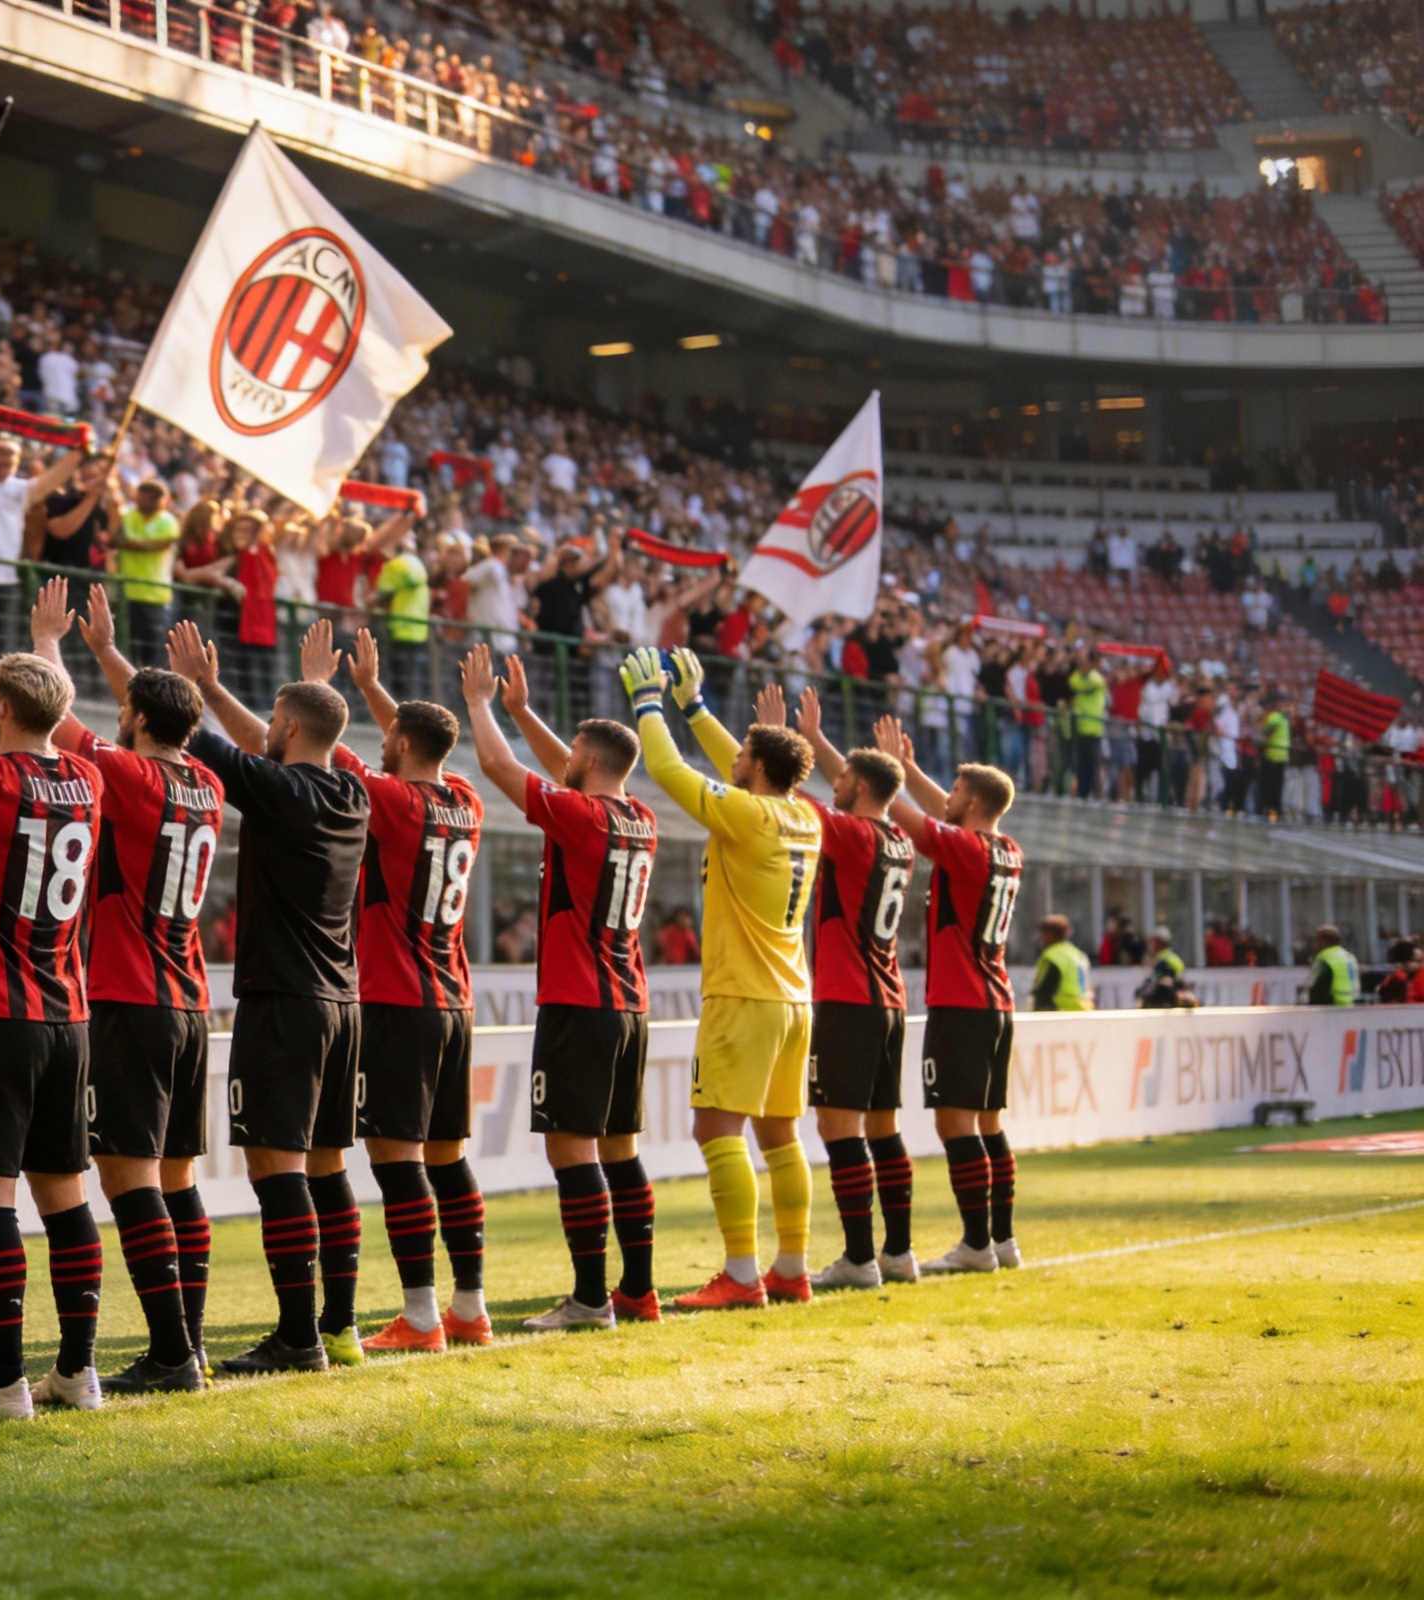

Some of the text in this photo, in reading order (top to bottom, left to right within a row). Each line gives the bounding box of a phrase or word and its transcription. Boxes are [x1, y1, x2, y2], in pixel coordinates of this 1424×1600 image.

[280, 244, 356, 308] ACM
[18, 816, 92, 921] 18
[160, 822, 217, 919] 10
[423, 836, 475, 925] 18
[875, 866, 908, 940] 6
